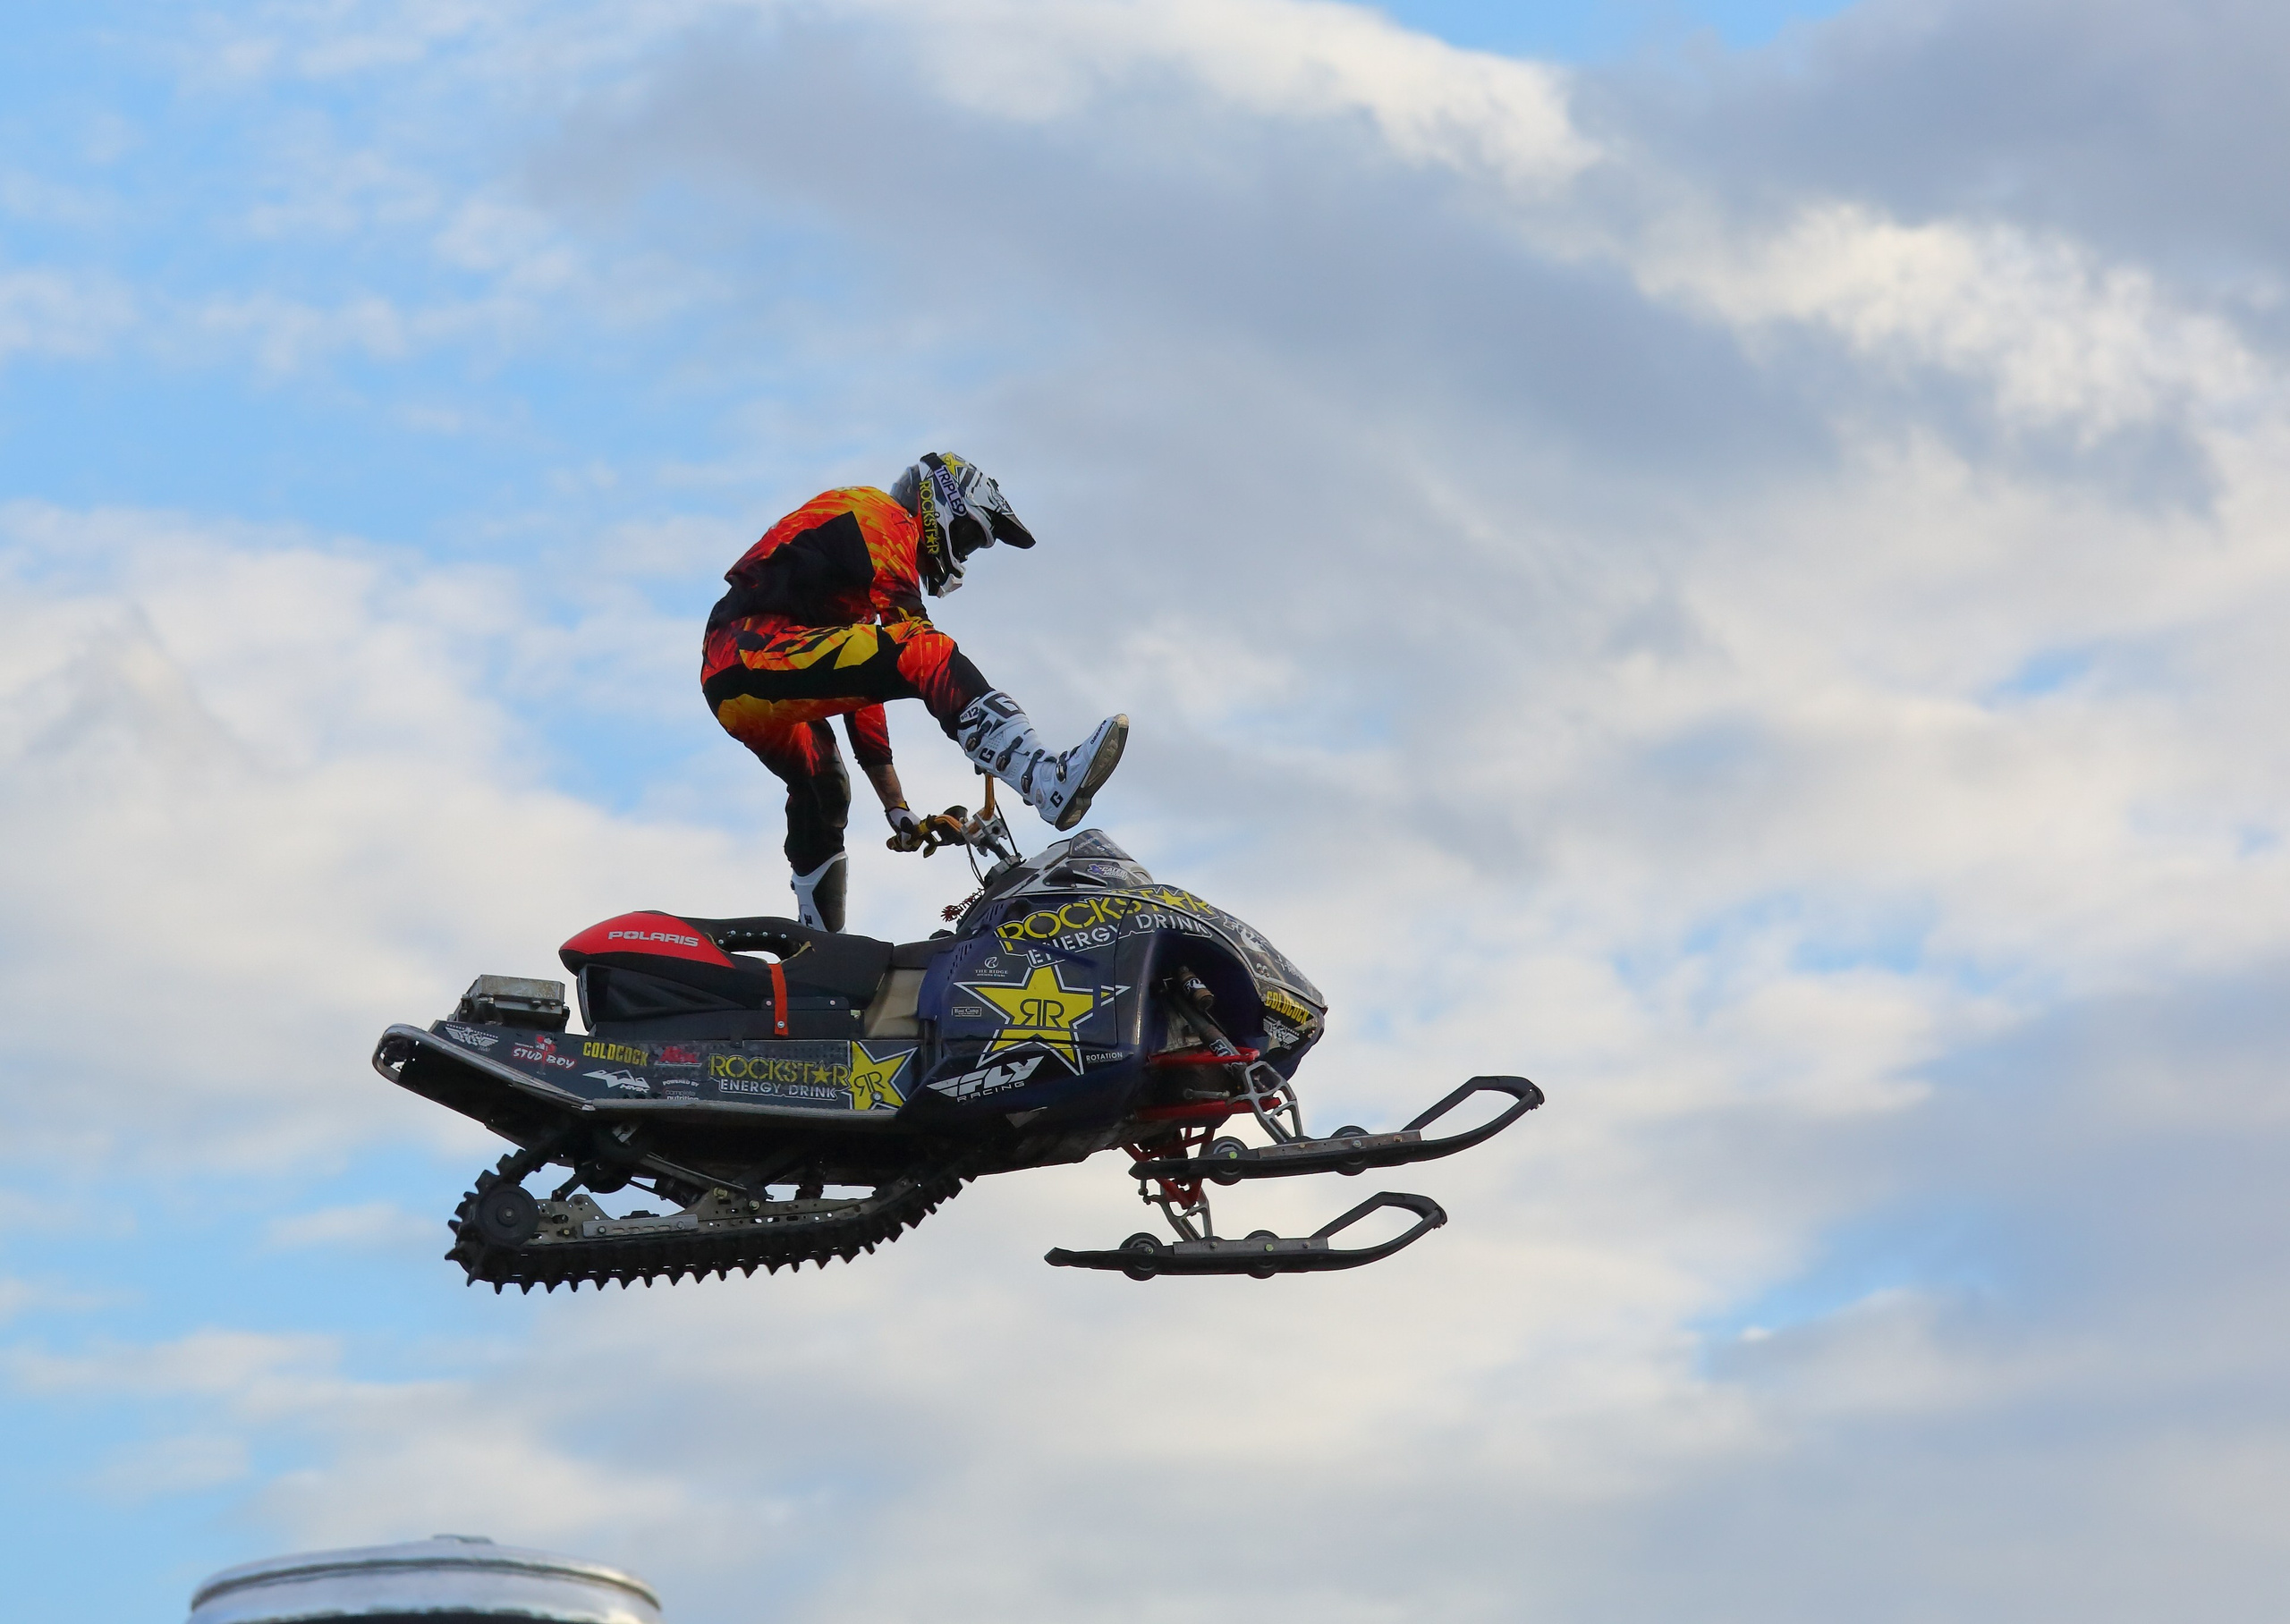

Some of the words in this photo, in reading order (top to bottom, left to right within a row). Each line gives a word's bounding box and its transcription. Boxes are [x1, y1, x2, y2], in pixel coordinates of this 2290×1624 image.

[937, 466, 967, 516] TRIPLE9
[1135, 913, 1209, 935] DRINK
[608, 931, 699, 947] POLARIS
[1266, 991, 1309, 1026] COLDCOCK
[513, 1048, 542, 1061] STUD
[546, 1055, 575, 1069] BOY
[583, 1042, 649, 1067] COLDCOCK
[1086, 1052, 1123, 1062] ROTATION
[954, 1056, 1044, 1096] FLY
[720, 1078, 781, 1094] ENERGY
[789, 1084, 837, 1099] DRINK
[956, 1081, 1025, 1102] RACING
